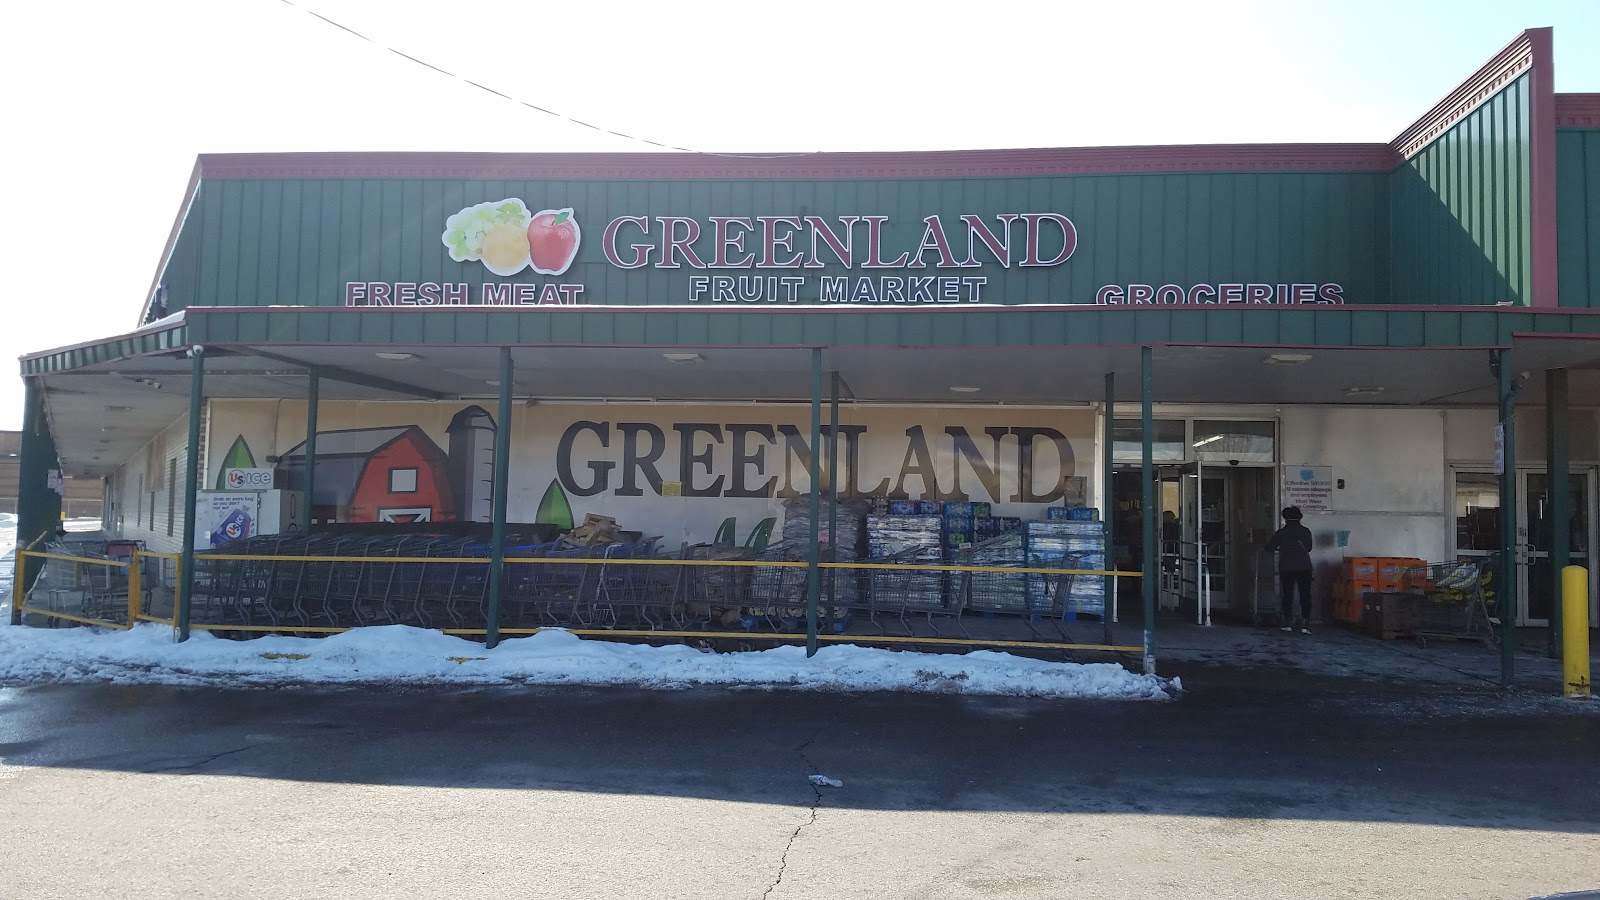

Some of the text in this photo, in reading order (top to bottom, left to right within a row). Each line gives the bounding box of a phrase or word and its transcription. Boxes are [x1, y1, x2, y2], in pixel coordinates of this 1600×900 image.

[602, 212, 1078, 270] GREENLAND
[346, 281, 584, 305] FRESH MEAT
[688, 276, 987, 302] FRUIT MARKET
[1096, 283, 1345, 304] GROCERIES
[556, 420, 1076, 505] GREENLAND
